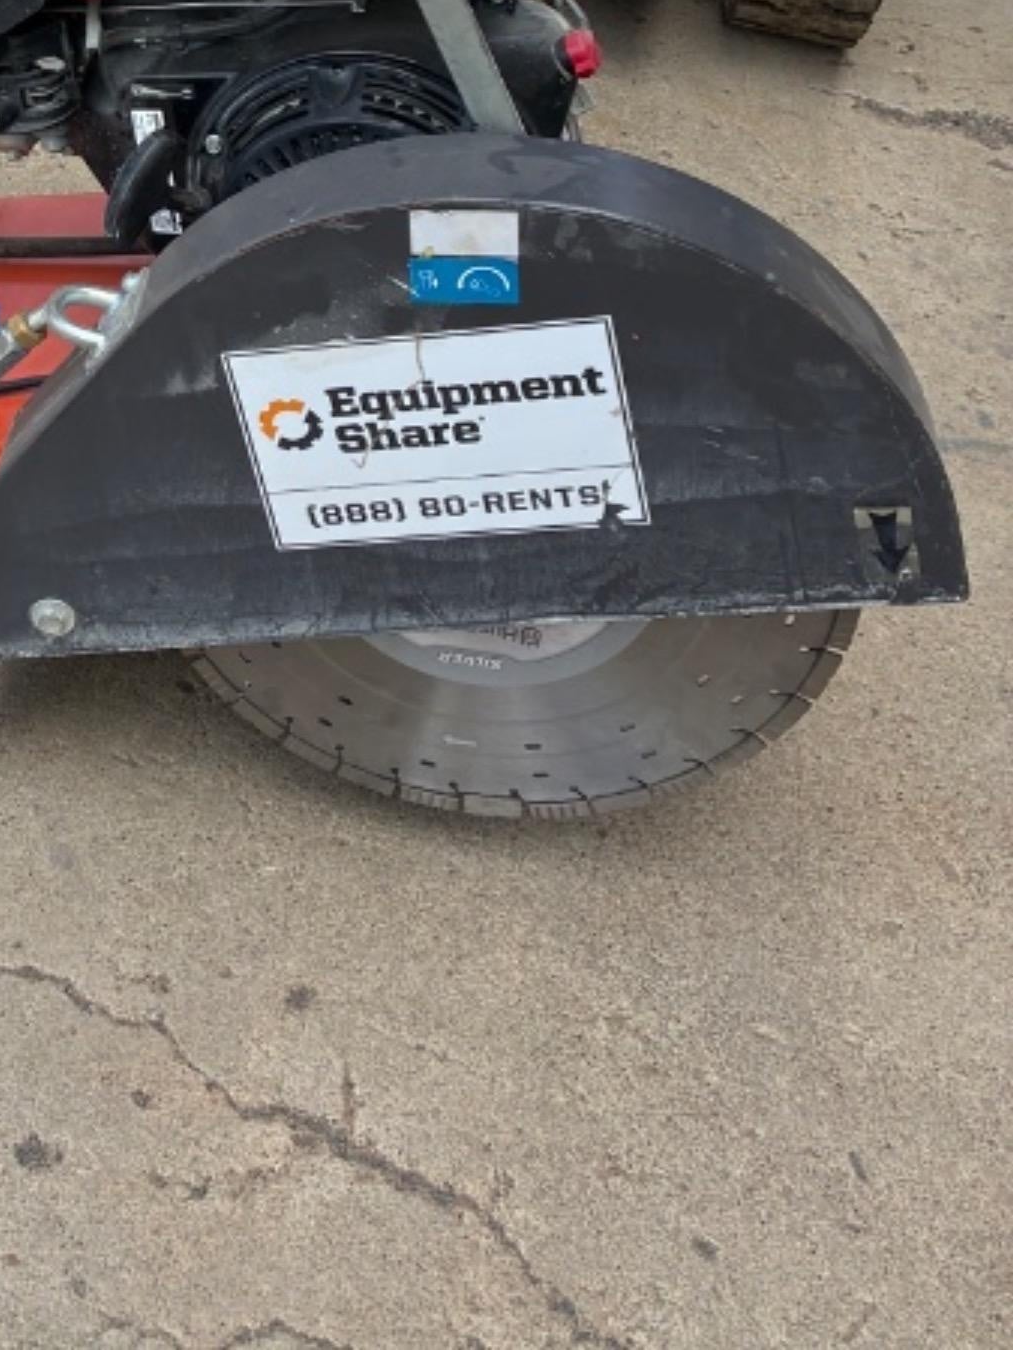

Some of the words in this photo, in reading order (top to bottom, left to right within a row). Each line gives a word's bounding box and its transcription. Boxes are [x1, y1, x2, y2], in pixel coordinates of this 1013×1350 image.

[325, 366, 606, 417] Equipment
[334, 418, 483, 454] Share
[306, 496, 407, 529] (888)
